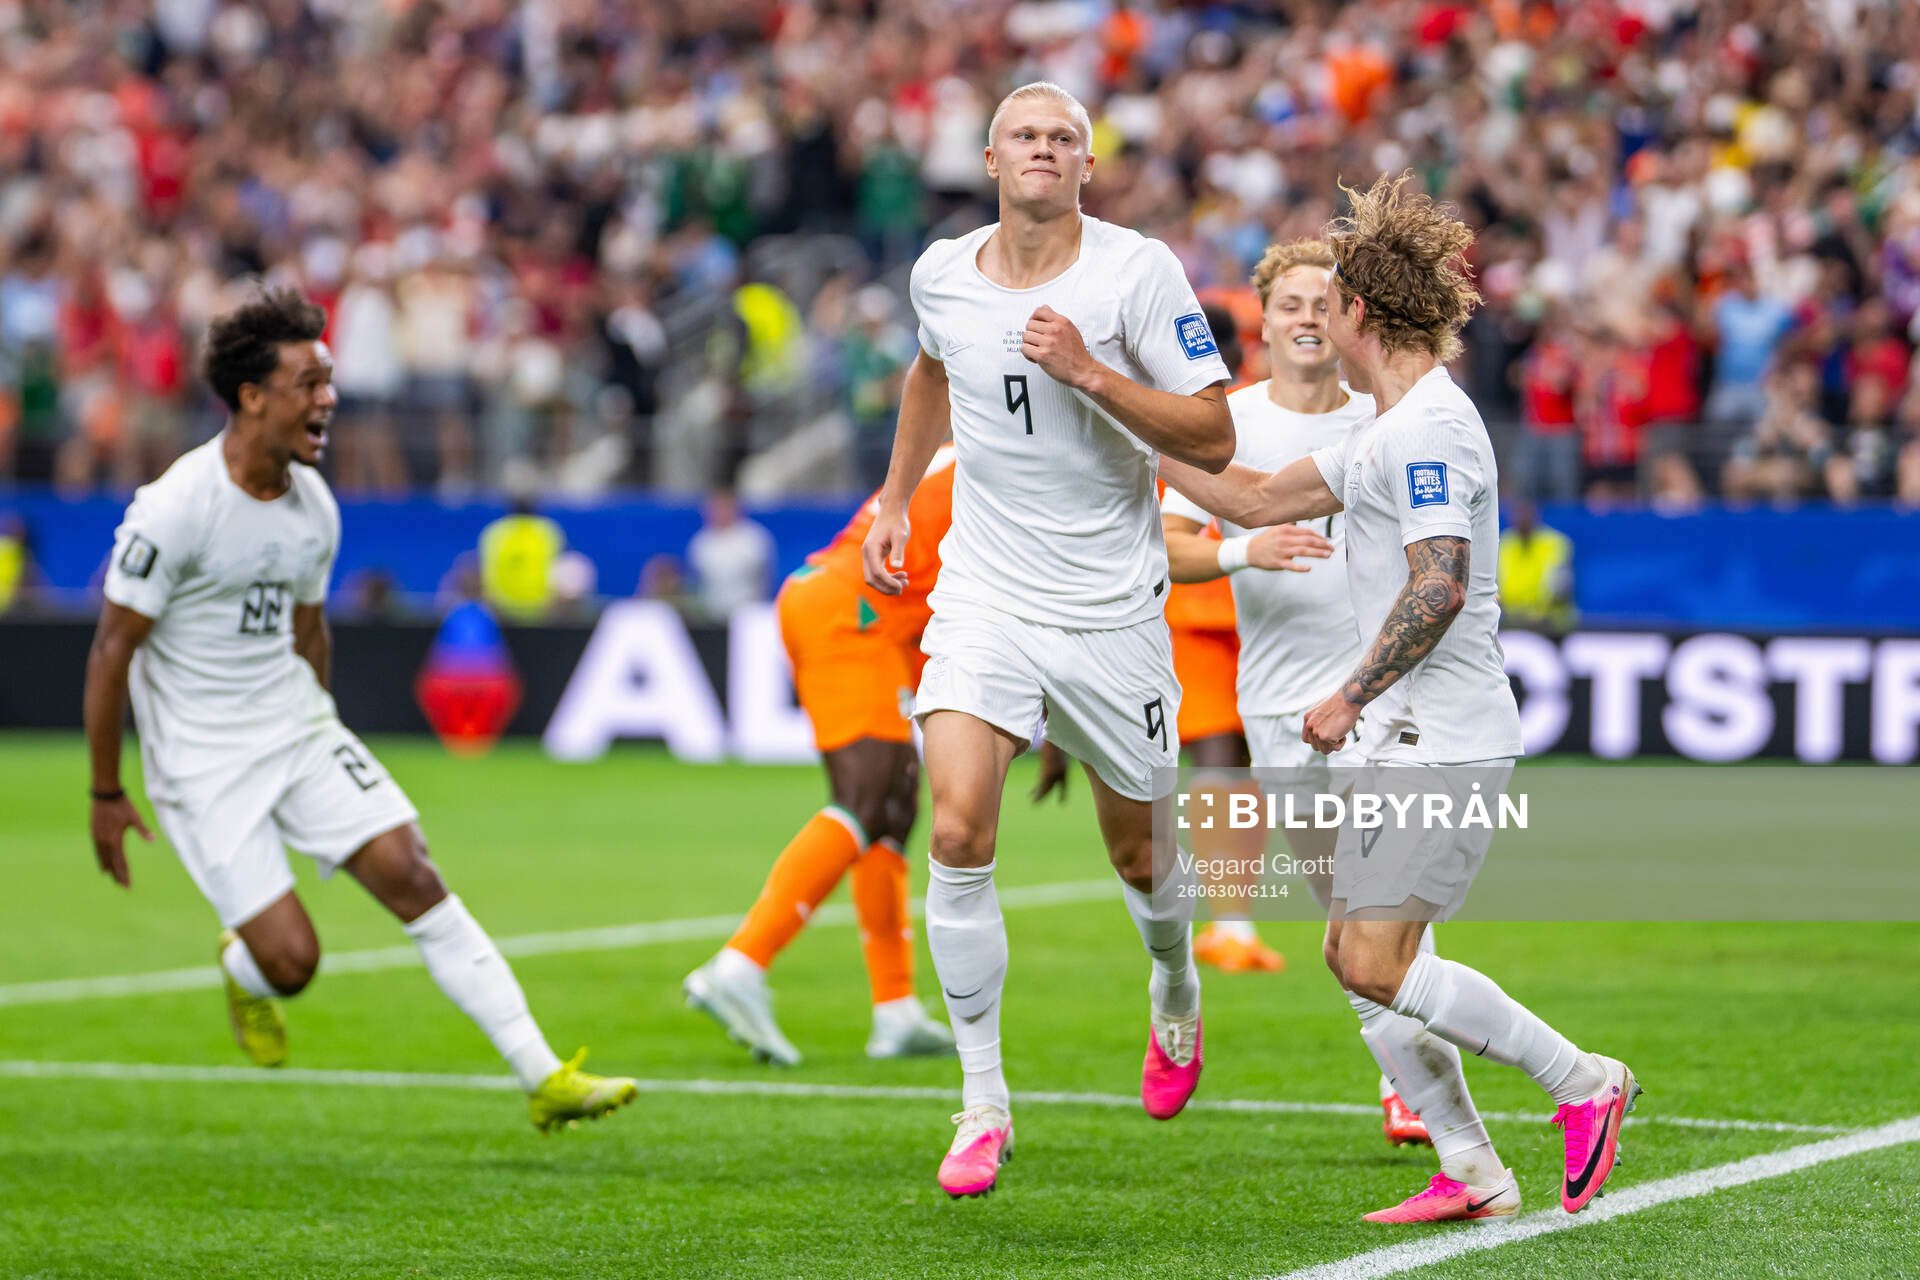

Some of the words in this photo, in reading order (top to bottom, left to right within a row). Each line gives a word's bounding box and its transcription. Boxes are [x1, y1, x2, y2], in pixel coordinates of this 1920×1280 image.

[1003, 374, 1034, 435] 9
[1413, 469, 1440, 477] FOOTBALL
[1414, 476, 1441, 487] UNITES
[239, 579, 289, 634] 22
[1143, 695, 1168, 752] 9
